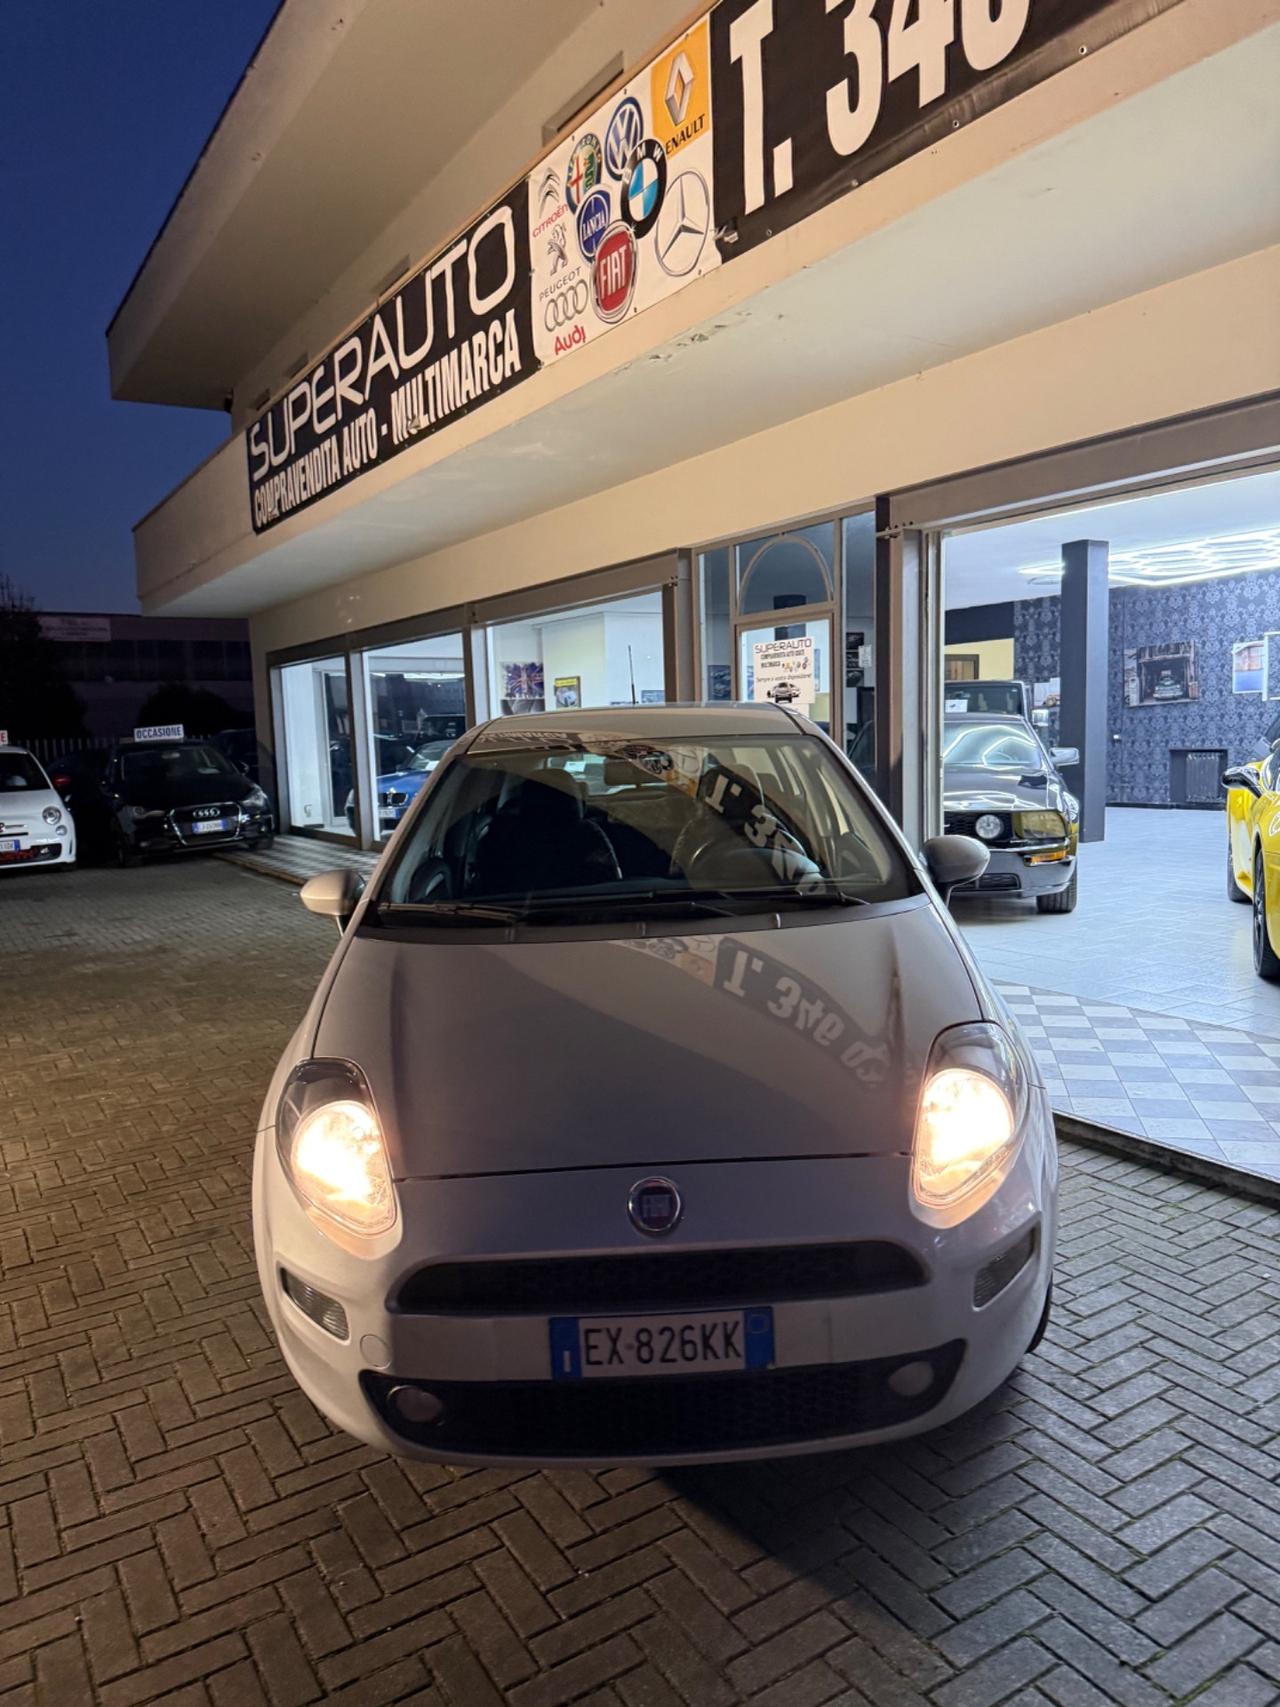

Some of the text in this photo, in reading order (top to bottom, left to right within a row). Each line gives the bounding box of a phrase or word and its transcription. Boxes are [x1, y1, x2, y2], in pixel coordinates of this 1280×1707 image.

[729, 0, 793, 215] T.
[665, 113, 705, 155] ENAULT
[539, 266, 581, 300] PEUGEOT
[600, 245, 627, 299] FIAT
[251, 205, 515, 481] SUPERAUTO
[554, 324, 587, 355] Audi
[254, 434, 341, 528] COMPRAVENDITA
[343, 407, 378, 475] AUTO
[391, 308, 522, 445] MULTIMARCA
[754, 638, 812, 653] SUPERAUTO
[136, 726, 183, 739] OCCASIONE
